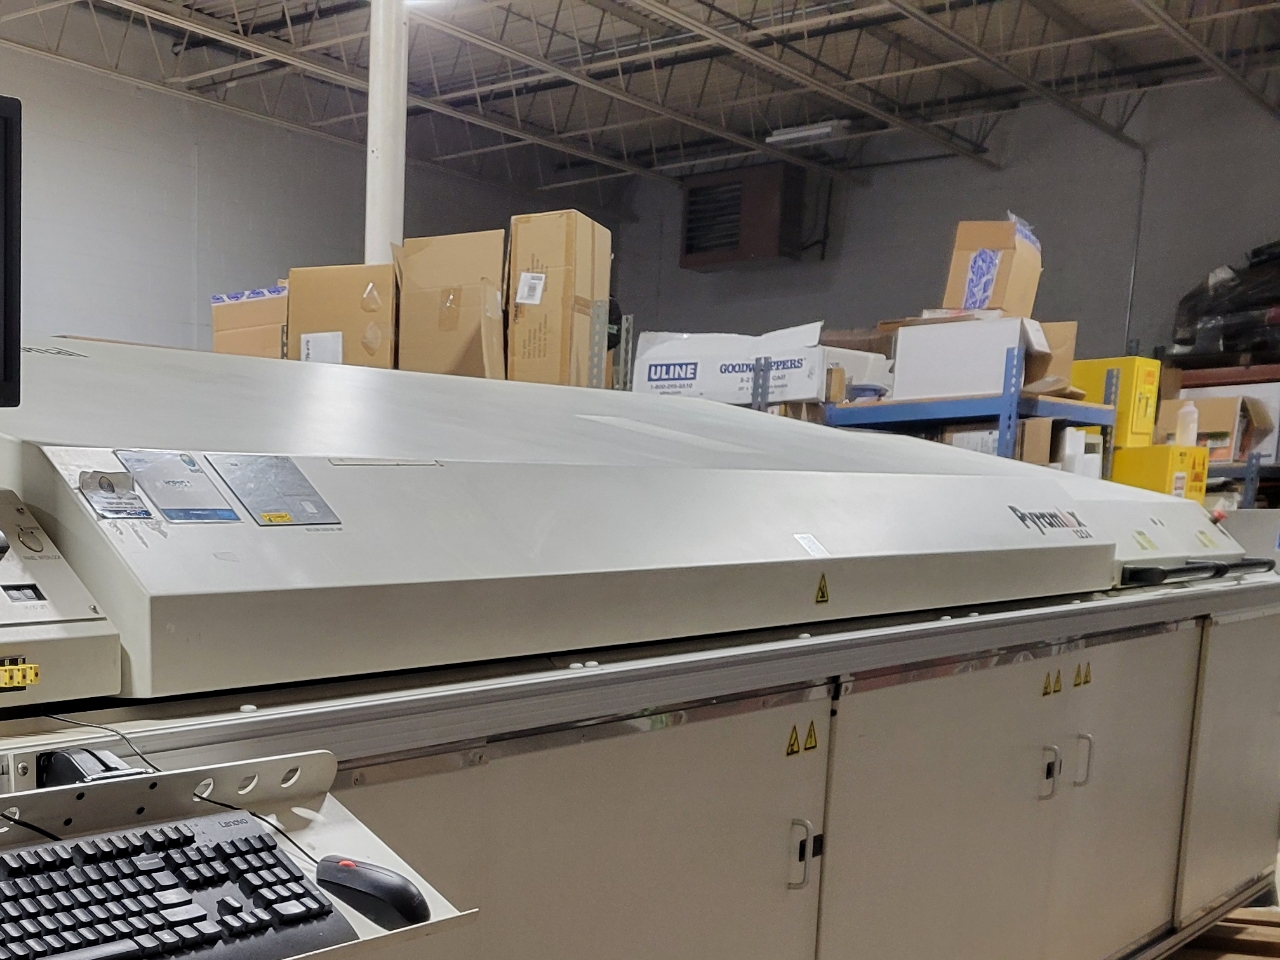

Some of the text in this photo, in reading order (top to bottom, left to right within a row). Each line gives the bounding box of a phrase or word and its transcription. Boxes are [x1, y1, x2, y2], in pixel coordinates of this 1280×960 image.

[649, 364, 696, 380] ULINE
[720, 358, 803, 374] GOODWPPERS
[217, 818, 249, 828] Lenovo
